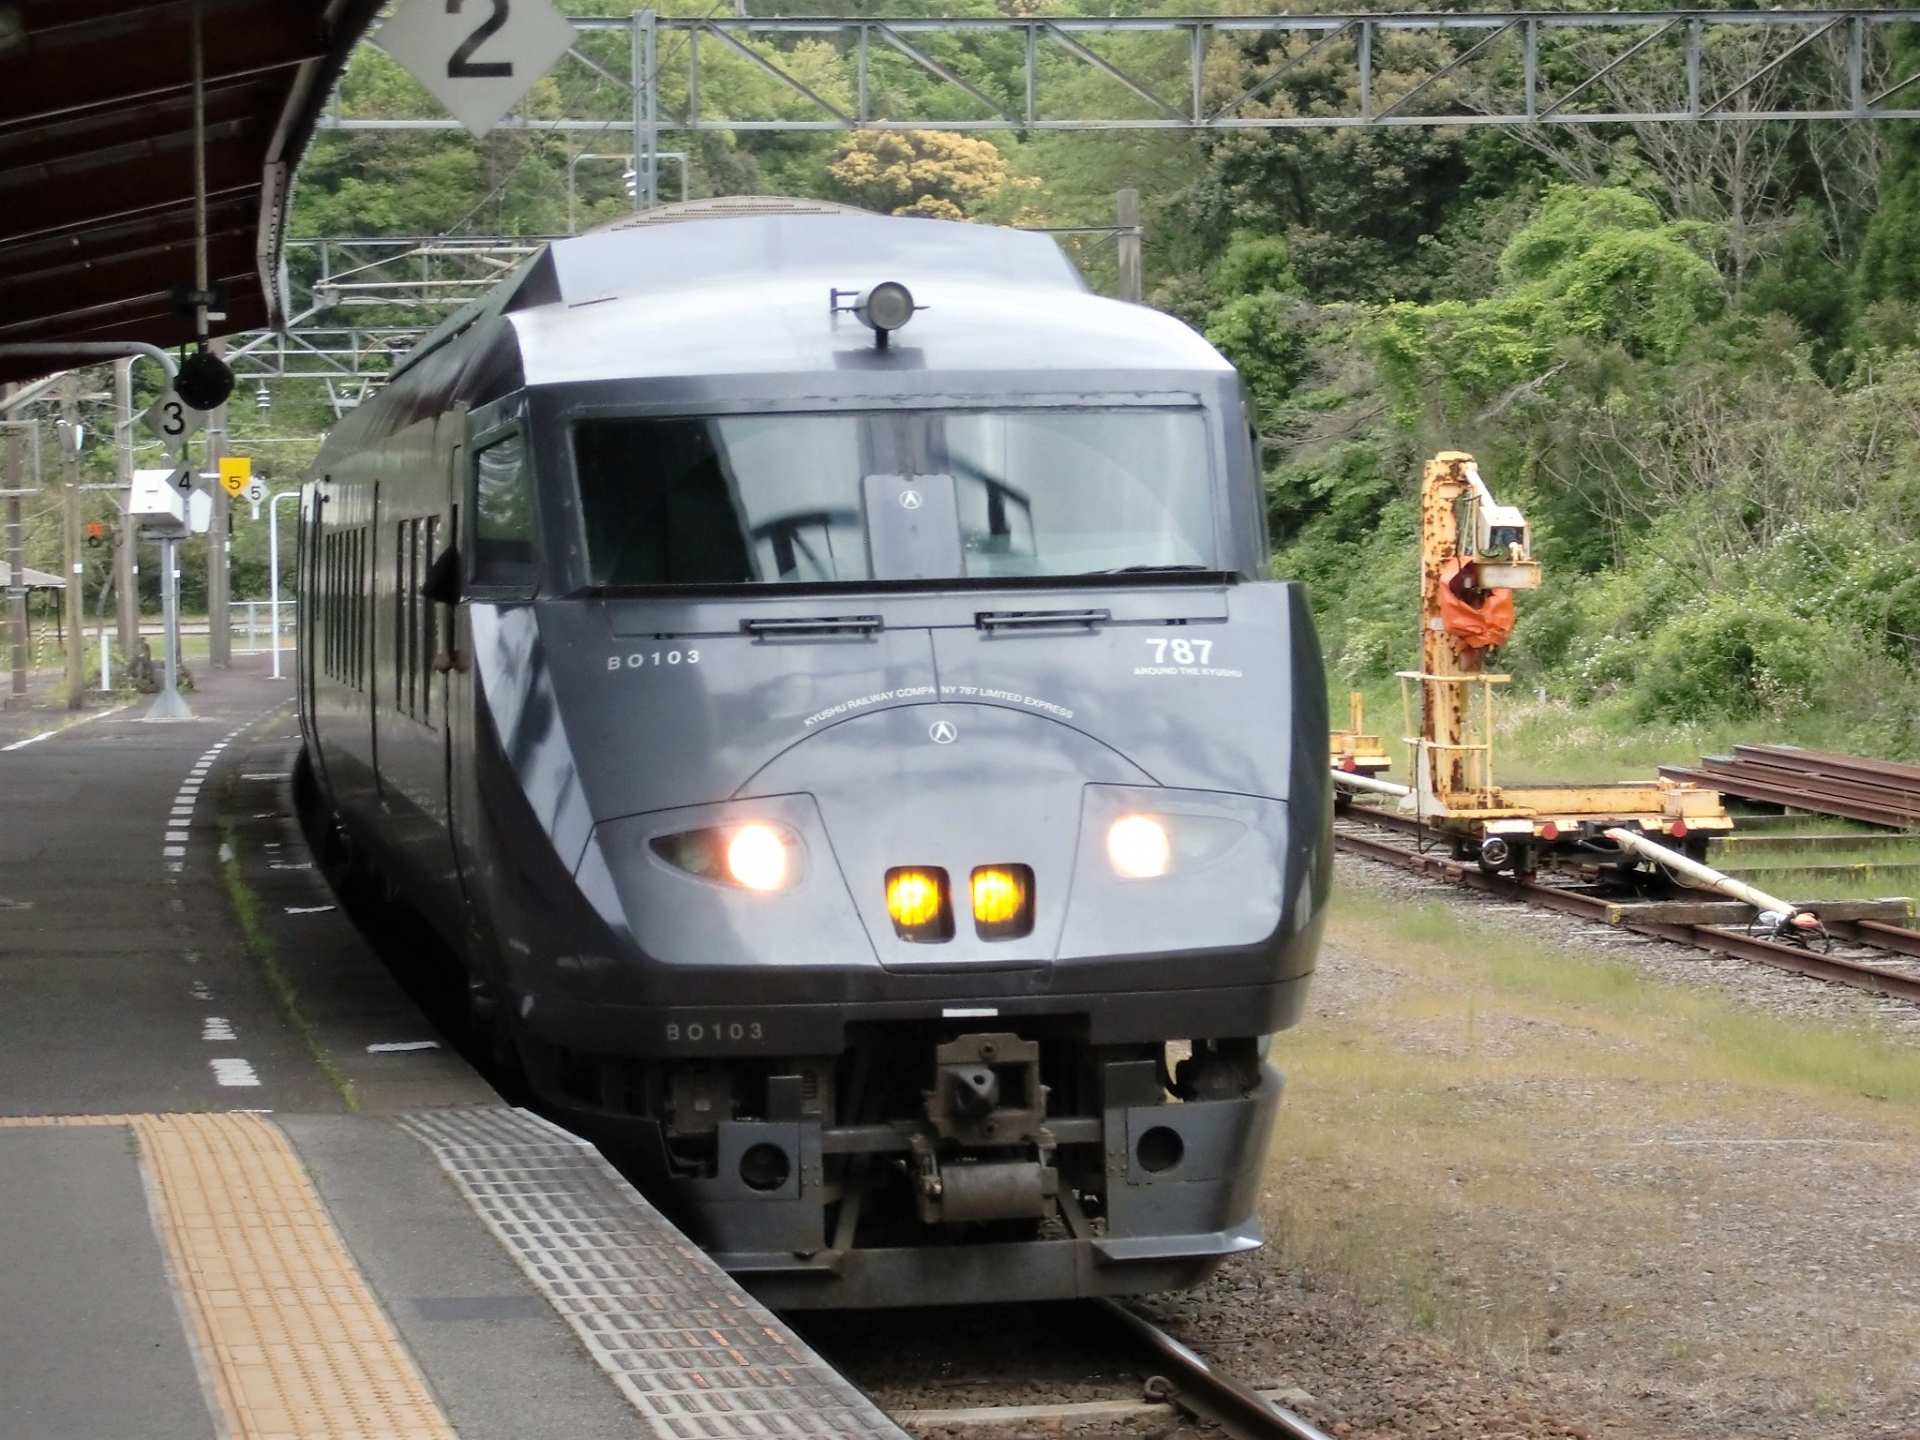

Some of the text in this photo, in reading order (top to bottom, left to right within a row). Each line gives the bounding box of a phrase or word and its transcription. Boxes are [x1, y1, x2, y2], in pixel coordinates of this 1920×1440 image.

[446, 0, 513, 78] 2
[163, 402, 185, 435] 3
[178, 471, 192, 490] 4
[229, 476, 241, 490] 5
[251, 486, 261, 500] 5
[1145, 638, 1213, 665] 787
[1133, 667, 1243, 678] AROUND THE KYUSHU
[803, 703, 847, 727] KYUSHU
[848, 689, 894, 710] RAILWAY
[959, 686, 978, 695] 787
[979, 688, 1022, 703] LIMITED
[1024, 696, 1074, 720] EXPRESS
